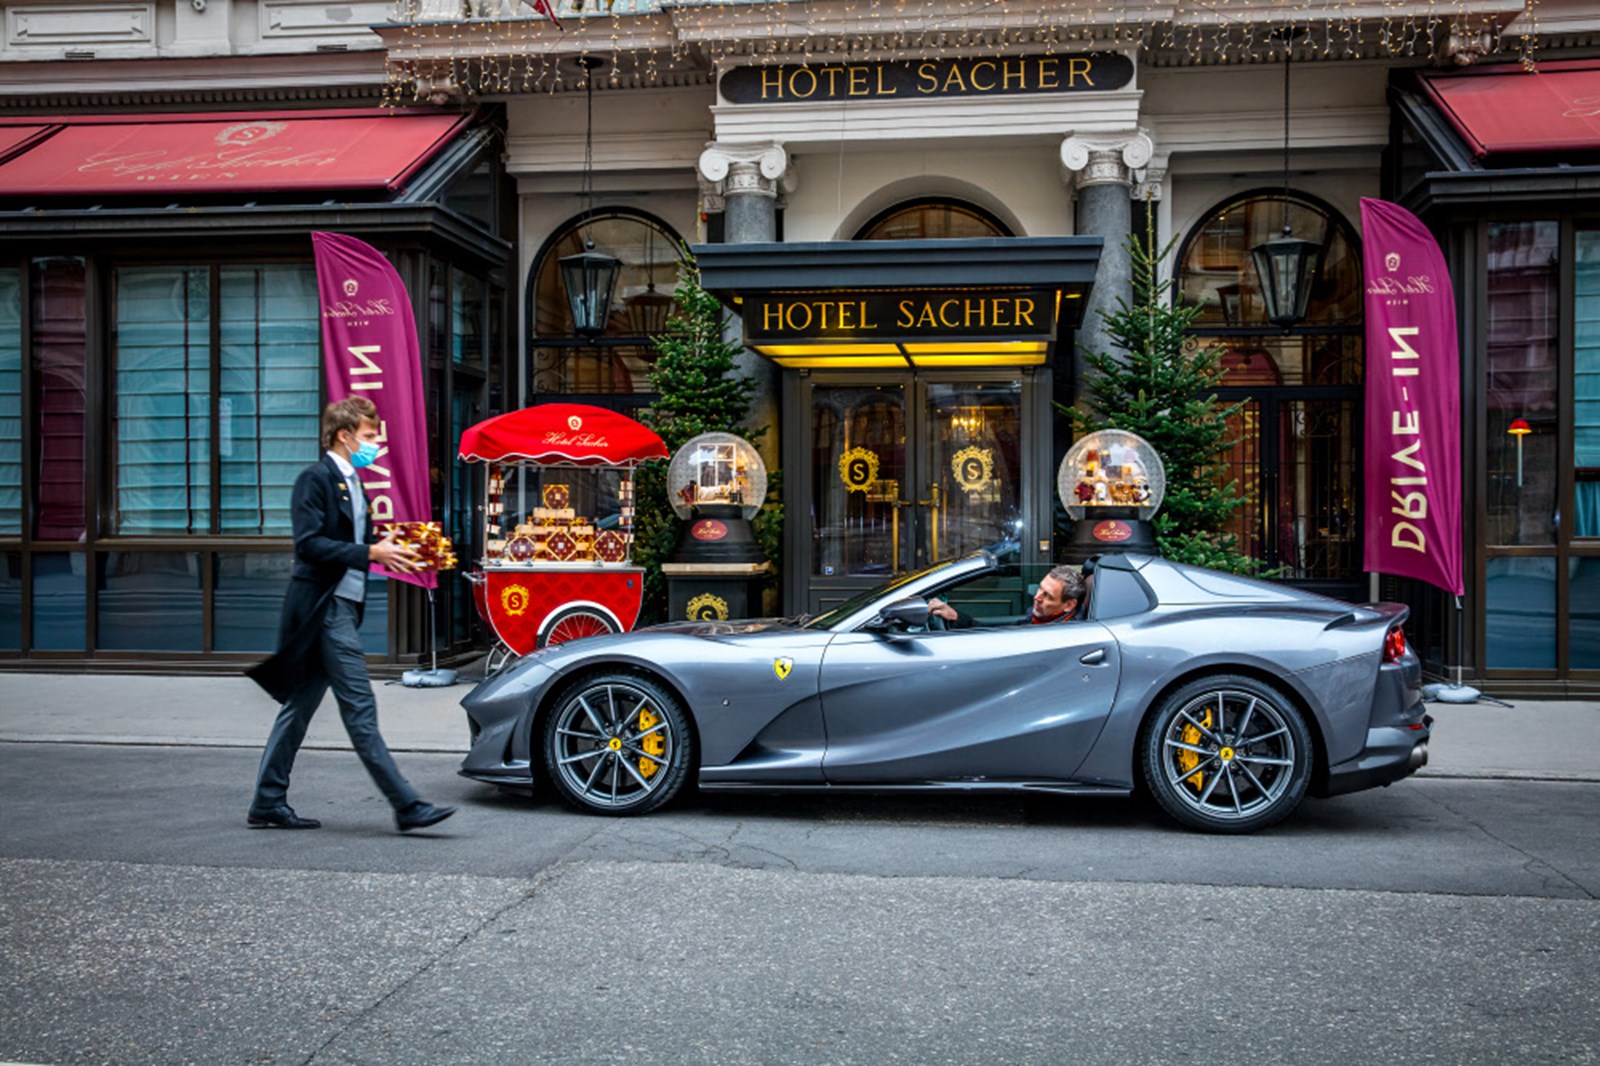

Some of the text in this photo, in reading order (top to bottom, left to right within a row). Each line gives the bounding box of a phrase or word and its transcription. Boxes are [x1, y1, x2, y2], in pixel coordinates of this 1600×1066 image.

[761, 58, 1095, 98] HOTEL SACHER
[762, 298, 1035, 331] HOTEL SACHER
[542, 432, 580, 446] Hotel
